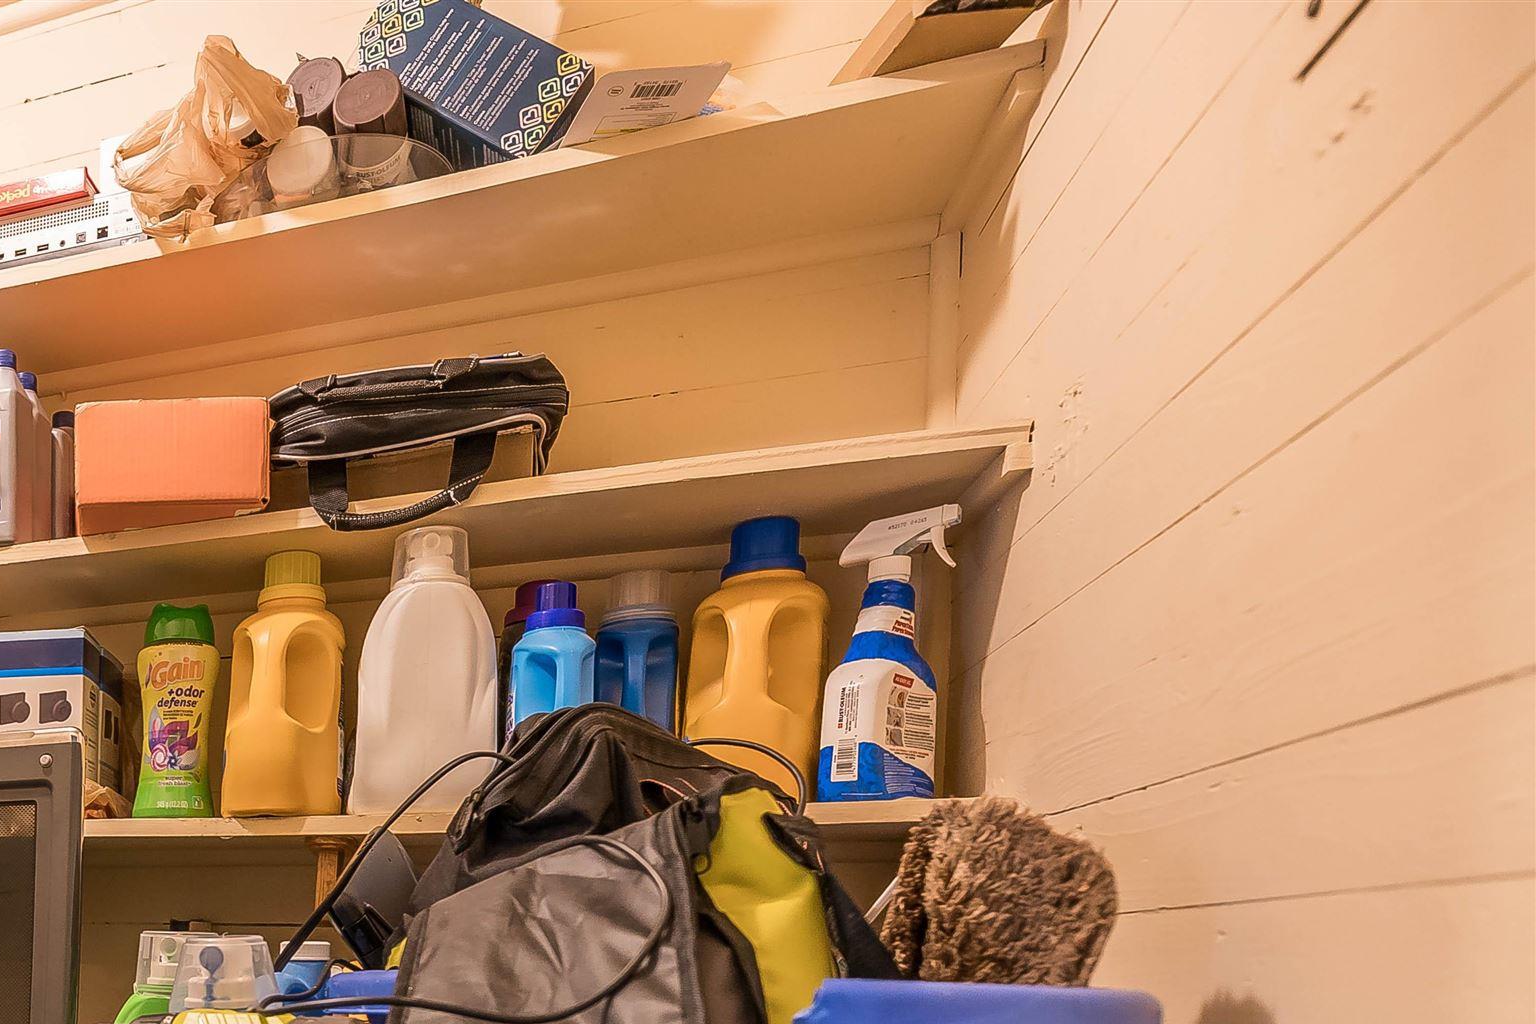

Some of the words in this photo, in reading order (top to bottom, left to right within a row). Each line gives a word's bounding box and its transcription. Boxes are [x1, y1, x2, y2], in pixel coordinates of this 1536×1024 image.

[150, 657, 205, 691] Gain
[167, 685, 205, 699] +odor
[157, 697, 198, 709] defense
